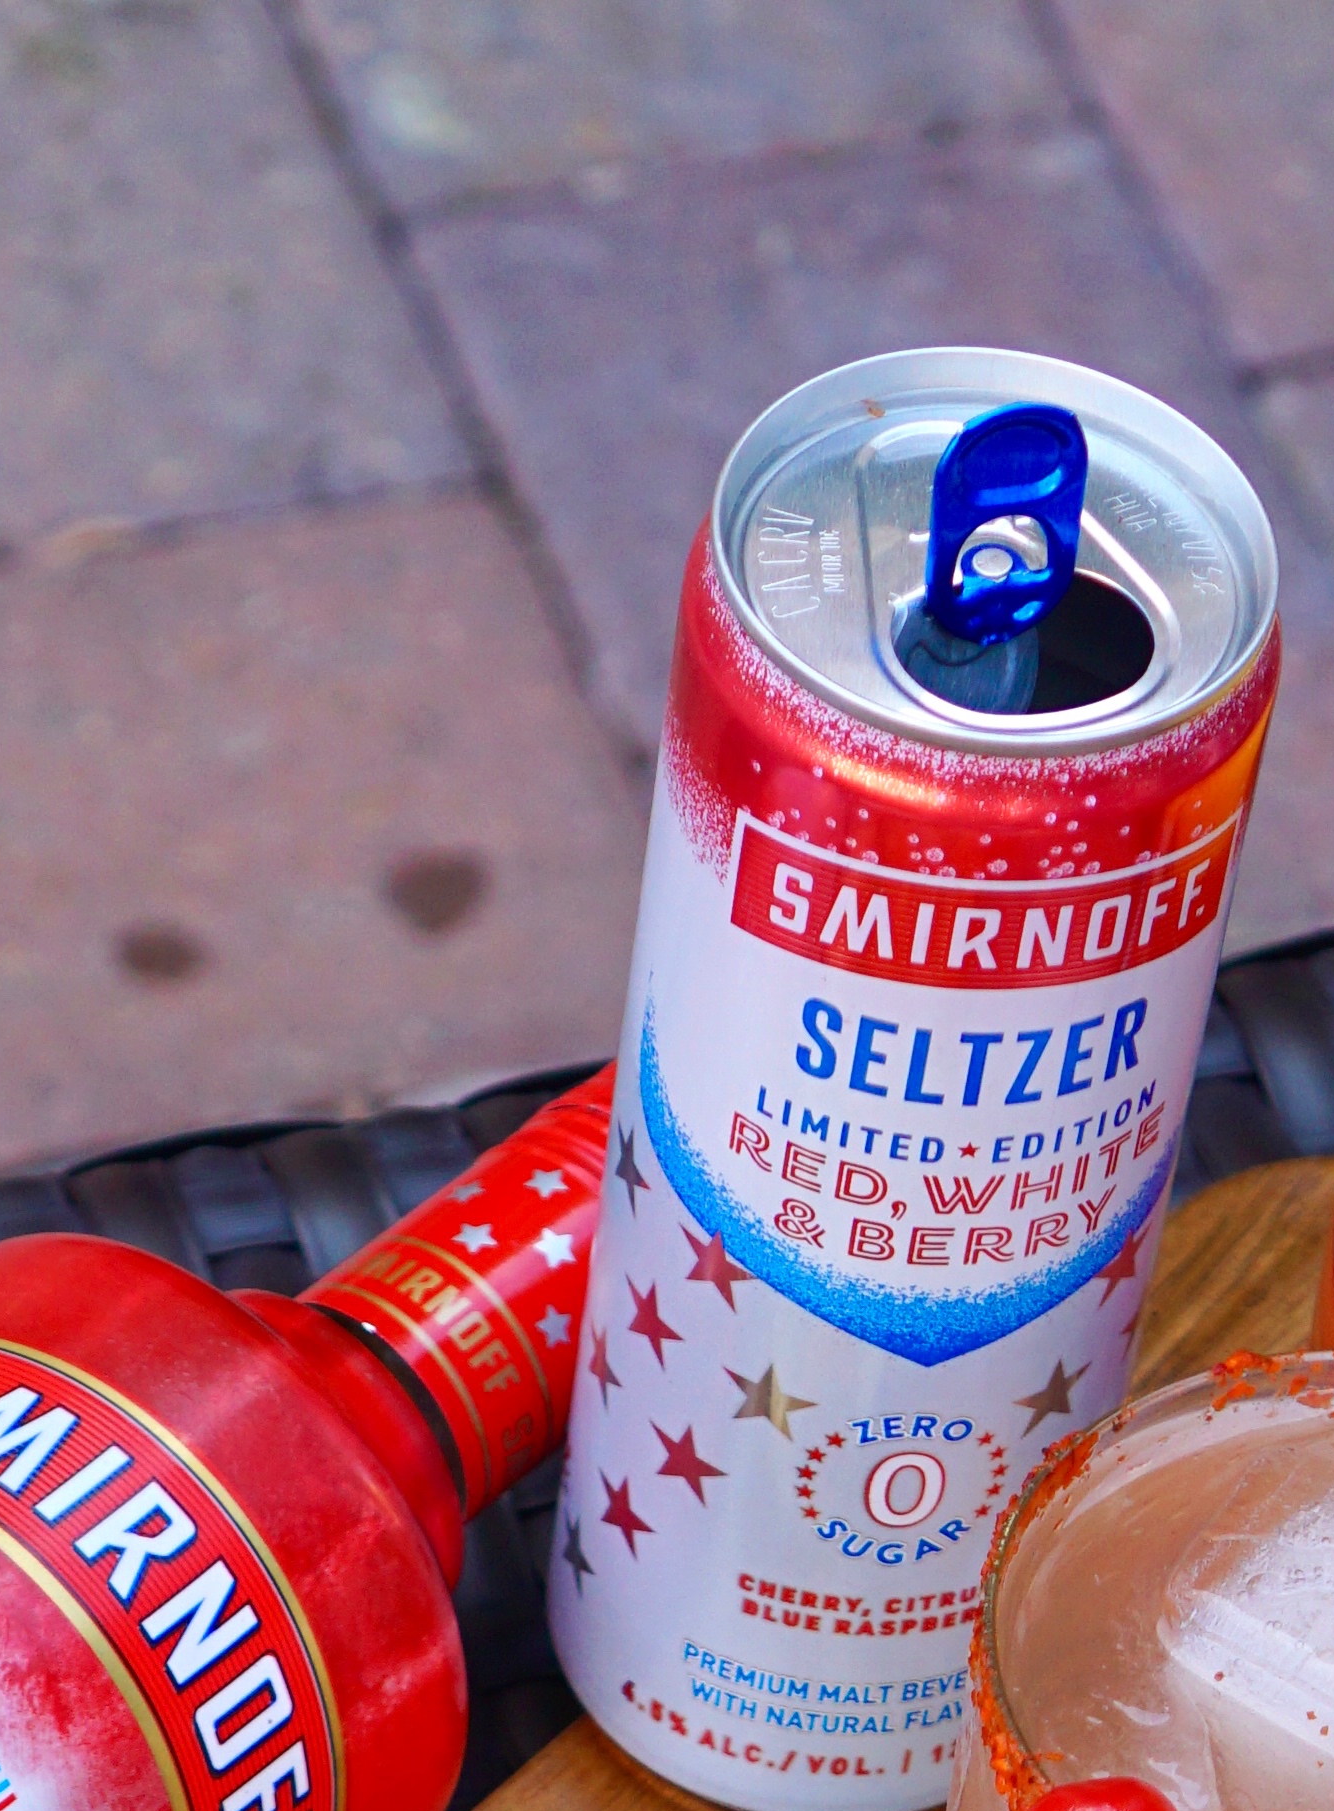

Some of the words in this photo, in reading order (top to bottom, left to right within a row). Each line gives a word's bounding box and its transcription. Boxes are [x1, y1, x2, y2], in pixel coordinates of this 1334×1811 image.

[795, 997, 1148, 1106] SELTZER
[757, 1084, 945, 1164] LIMITED
[992, 1080, 1156, 1163] EDITION
[729, 1112, 906, 1220] RED,
[923, 1103, 1165, 1214] WHITE
[774, 1198, 827, 1248] &
[848, 1189, 1115, 1266] BERRY
[849, 1414, 974, 1445] ZERO
[815, 1518, 971, 1566] SUGAR
[738, 1573, 871, 1617] CHERRY,
[885, 1585, 980, 1614] CITRU
[741, 1599, 820, 1631] BLUE
[833, 1605, 980, 1637] RASPBER
[683, 1641, 809, 1699] PREMIUM
[819, 1683, 893, 1705] MALT
[902, 1669, 968, 1702] BEVE
[691, 1679, 758, 1720] WITH
[767, 1707, 893, 1734] NATURAL
